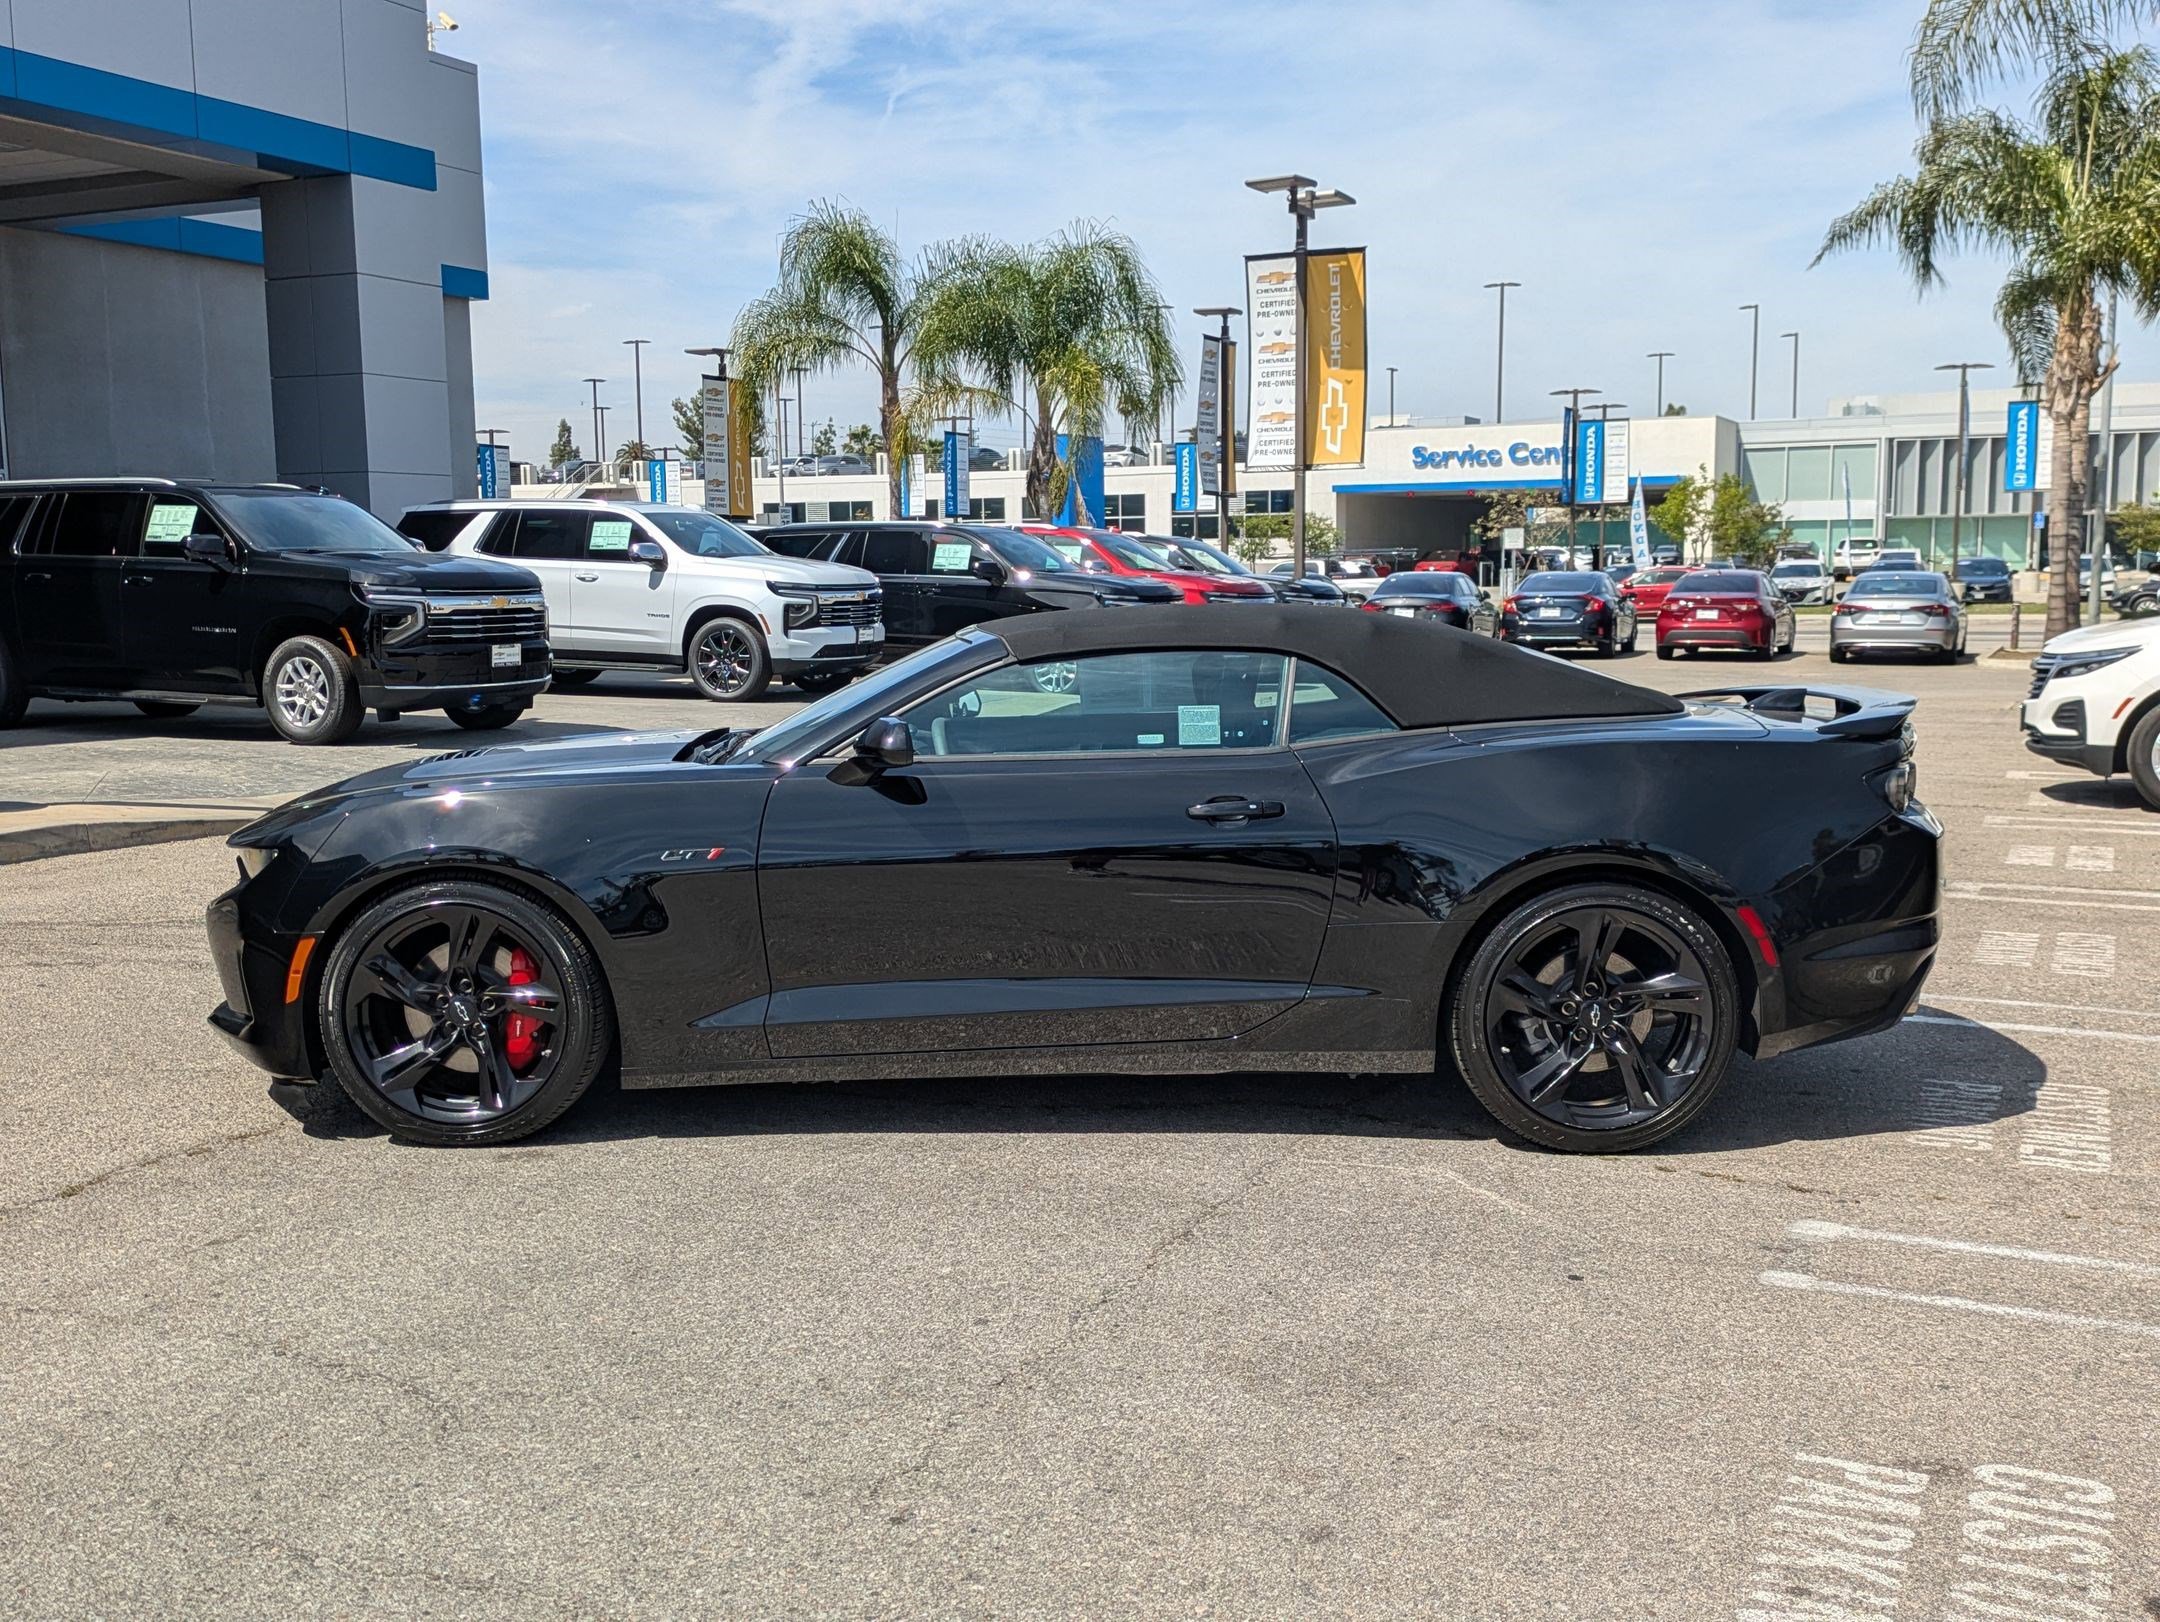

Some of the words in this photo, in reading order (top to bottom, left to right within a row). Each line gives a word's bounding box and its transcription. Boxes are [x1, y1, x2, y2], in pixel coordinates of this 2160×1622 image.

[1256, 309, 1297, 318] PRE-OWNE
[1260, 299, 1297, 308] CERTIFIED
[1328, 262, 1341, 370] CHEVROLET
[1257, 379, 1297, 388] PRE-OWNE
[1258, 439, 1295, 447] CERTIFIED
[1412, 443, 1503, 470] Service
[1508, 442, 1563, 467] Cen
[1585, 425, 1596, 485] HONDA
[2015, 406, 2029, 471] HONDA
[1182, 447, 1190, 497] HONDA
[1905, 1078, 2003, 1151] PARKING
[2020, 1081, 2111, 1173] CUSTOMER
[1944, 1464, 2115, 1622] CUSTO
